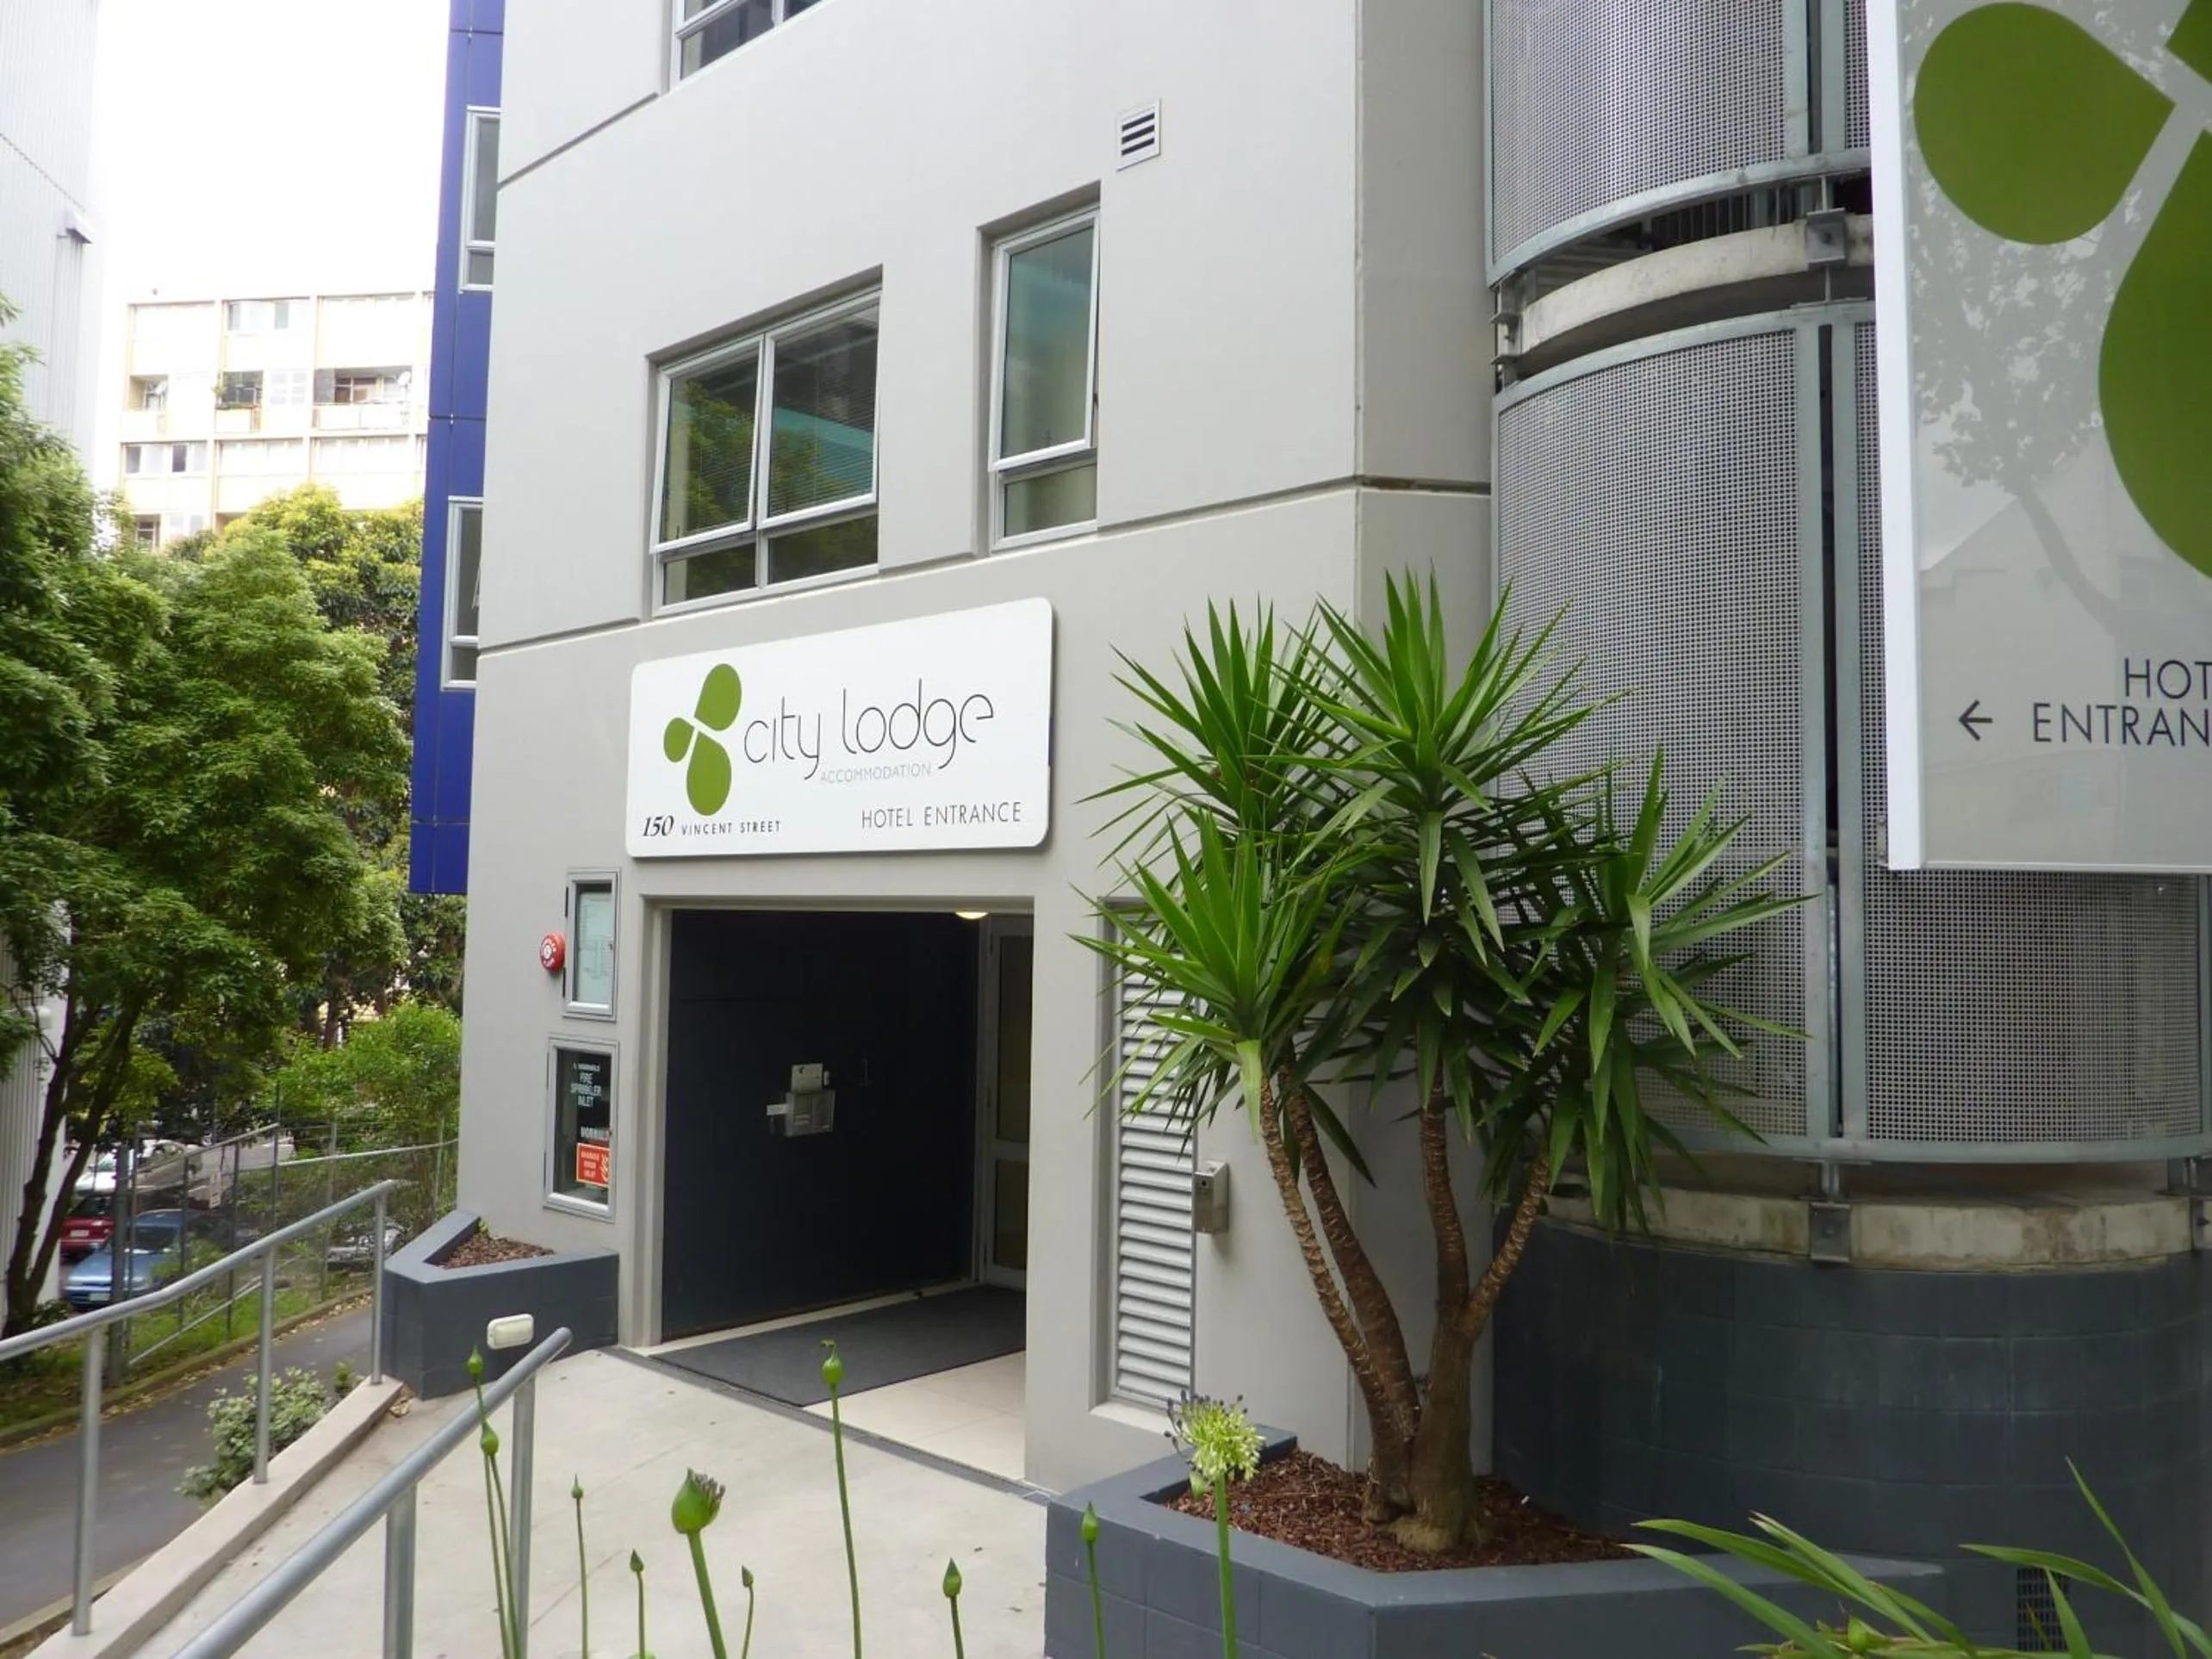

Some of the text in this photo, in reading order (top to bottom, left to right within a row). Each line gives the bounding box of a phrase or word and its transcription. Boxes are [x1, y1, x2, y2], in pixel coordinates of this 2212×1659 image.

[743, 677, 994, 780] city lodge
[820, 762, 932, 784] ACCOMMODATION
[642, 814, 780, 837] 150 VINCENT STREET
[861, 800, 1022, 830] HOTEL ENTRANCE
